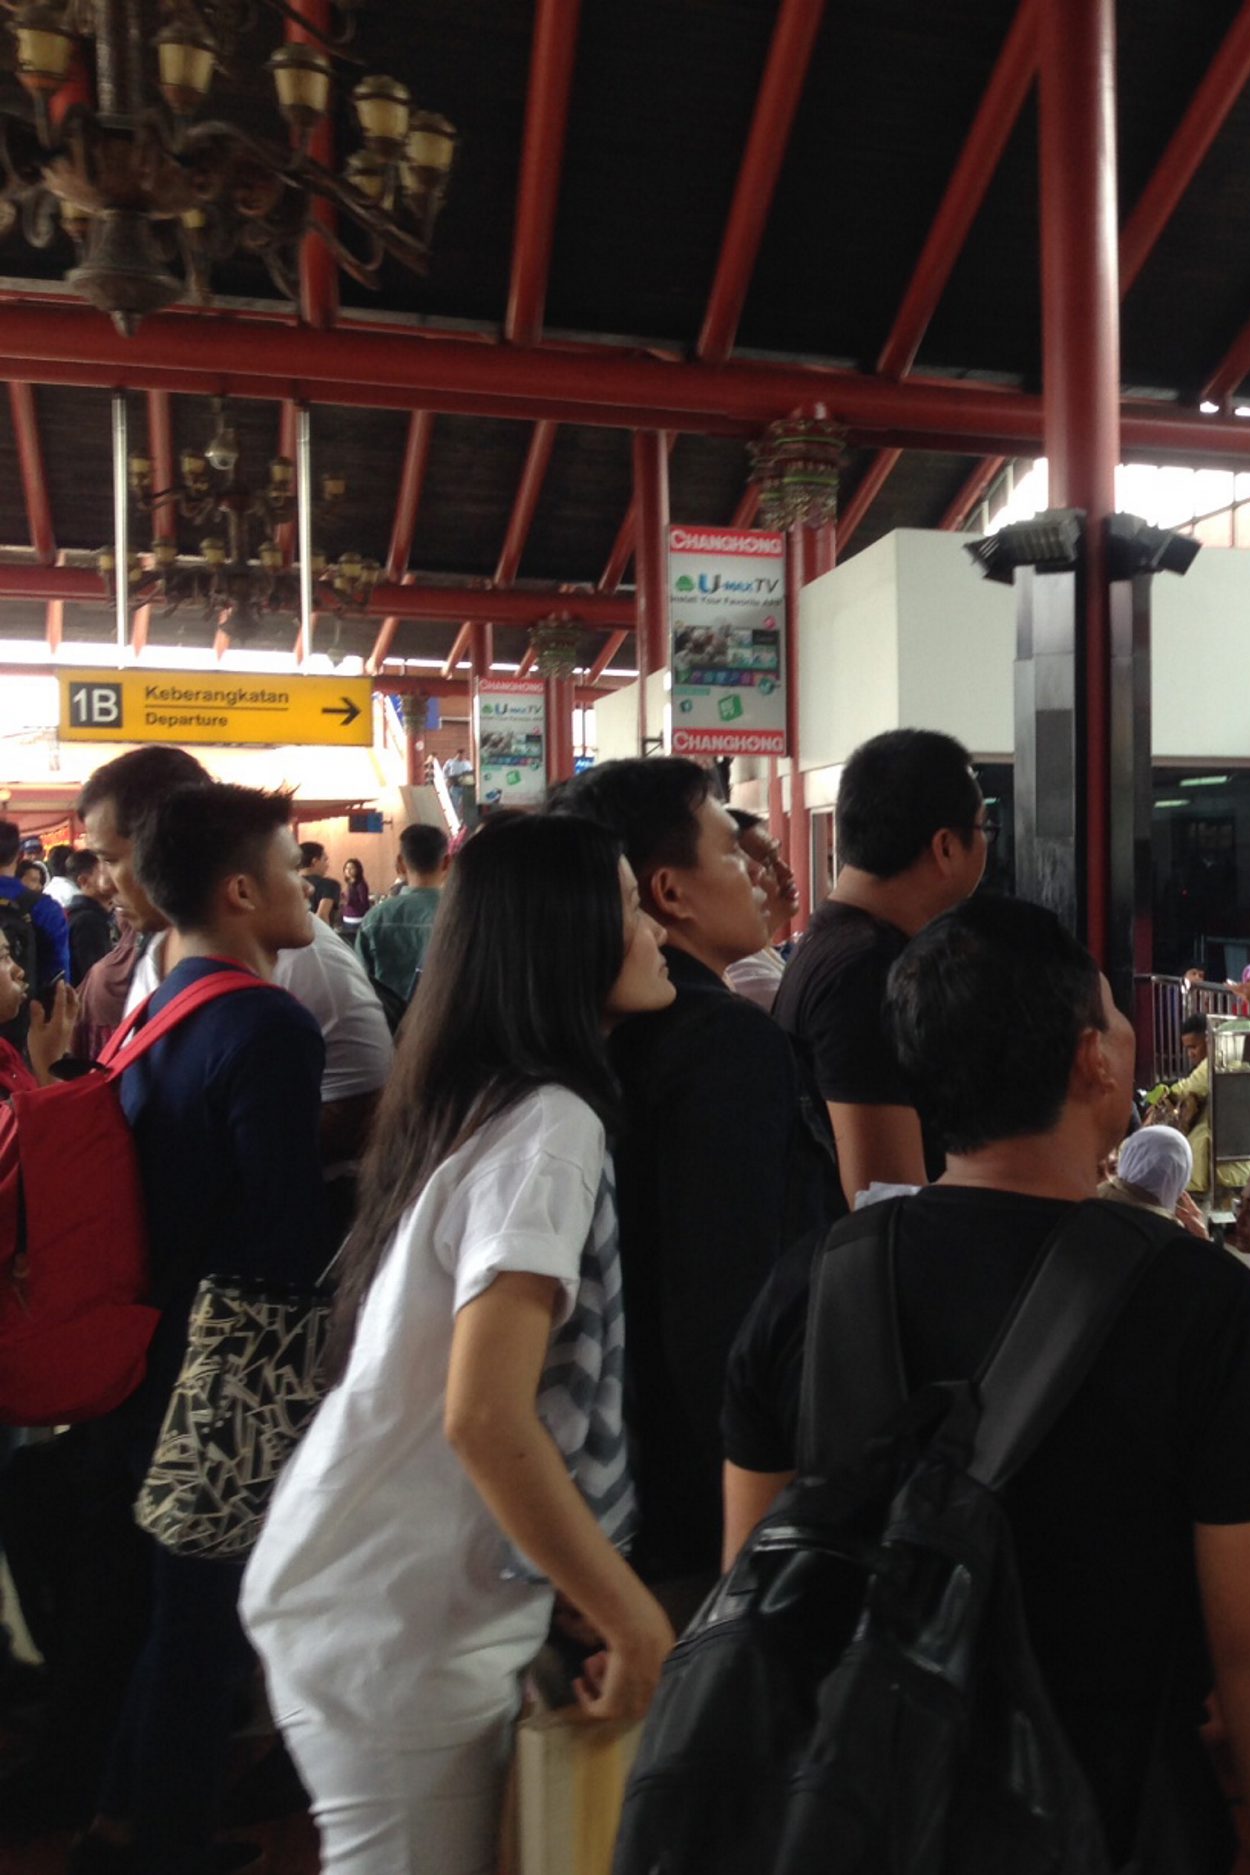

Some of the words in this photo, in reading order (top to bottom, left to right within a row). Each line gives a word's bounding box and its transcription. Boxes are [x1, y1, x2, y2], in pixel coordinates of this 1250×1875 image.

[671, 529, 782, 554] CHANGHONG
[71, 687, 119, 723] 1B
[144, 685, 289, 706] Keberangkatan
[144, 711, 229, 728] Departure
[672, 732, 784, 753] CHANGHONG
